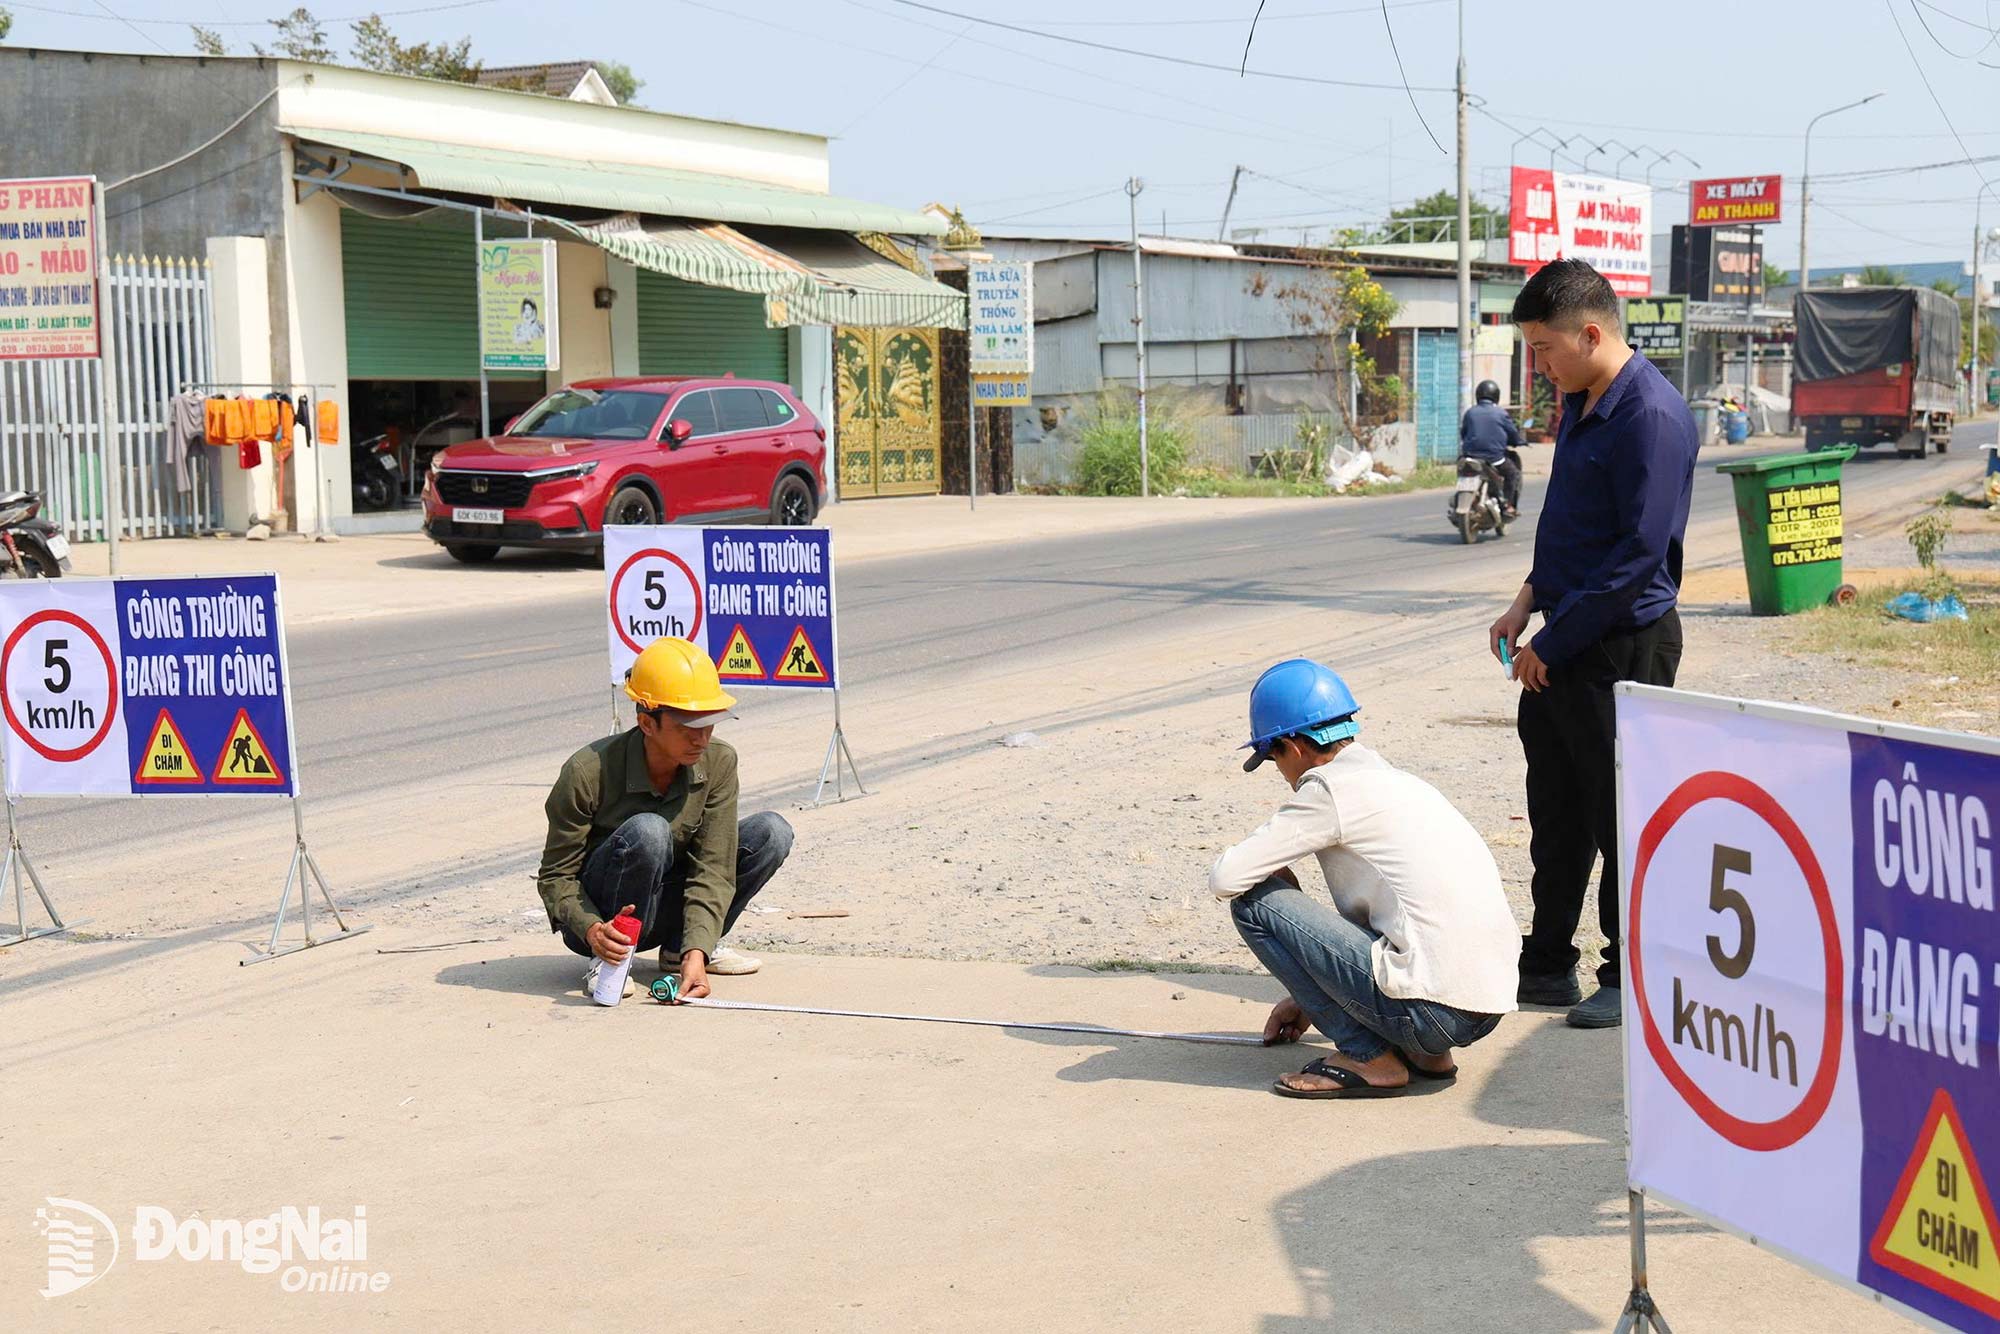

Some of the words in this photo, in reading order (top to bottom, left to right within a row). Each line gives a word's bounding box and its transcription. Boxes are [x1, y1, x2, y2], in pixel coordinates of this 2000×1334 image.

[17, 186, 84, 210] PHAN
[1706, 184, 1727, 199] XE
[1730, 177, 1767, 198] MÁY
[1576, 200, 1596, 220] AN
[1600, 196, 1641, 225] THÀNH
[1696, 205, 1719, 220] AN
[1723, 200, 1775, 218] THÀNH
[0, 222, 20, 240] MUA
[23, 217, 43, 240] BÁN
[1612, 226, 1643, 252] PHÁT
[975, 267, 996, 282] TRÀ
[974, 322, 997, 334] NHÀ
[1774, 523, 1800, 533] 10TR
[1811, 519, 1840, 529] 200TR
[712, 535, 755, 573] CÔNG
[758, 535, 820, 574] TRƯỜNG
[644, 570, 667, 611] 5
[708, 583, 751, 616] ĐANG
[755, 584, 780, 616] THI
[783, 579, 827, 617] CÔNG
[126, 589, 184, 640] CÔNG
[186, 584, 267, 639] TRƯỜNG
[629, 615, 684, 637] km/h
[735, 642, 744, 655] ĐI
[43, 639, 71, 694] 5
[125, 655, 181, 697] ĐANG
[184, 654, 216, 697] THI
[220, 645, 278, 697] CÔNG
[728, 657, 751, 672] CHẬM
[26, 699, 95, 730] km/h
[161, 733, 173, 749] ĐI
[154, 752, 182, 774] CHẬM
[1873, 761, 1995, 912] CÔNG
[1706, 843, 1756, 980] 5
[1861, 927, 1980, 1070] ĐANG
[1672, 976, 1799, 1088] km/h
[1936, 1157, 1957, 1202] ĐI
[1917, 1207, 1980, 1270] CHẬM
